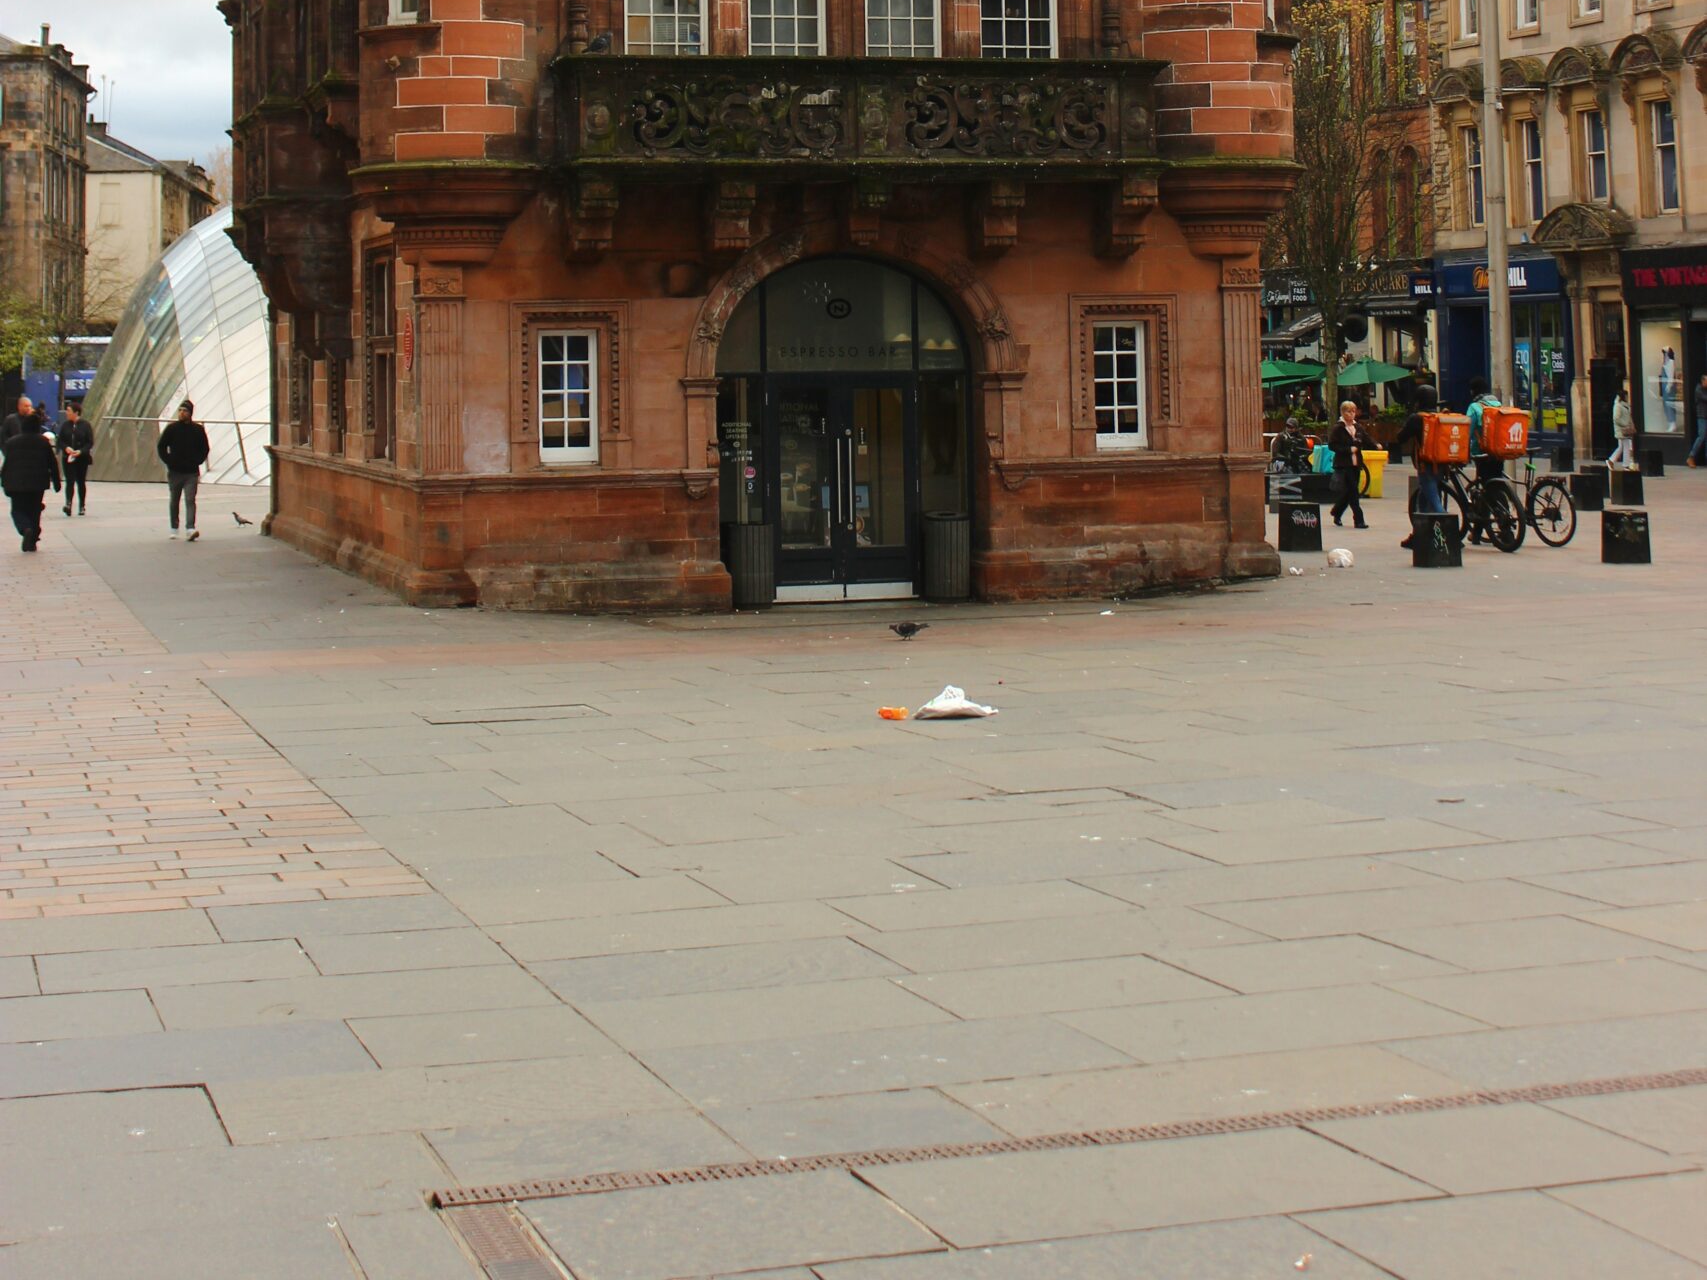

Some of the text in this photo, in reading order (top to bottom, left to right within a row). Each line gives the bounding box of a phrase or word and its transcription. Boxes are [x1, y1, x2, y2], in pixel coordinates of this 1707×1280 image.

[1632, 267, 1658, 288] THE
[1414, 285, 1432, 294] HILL
[1292, 294, 1308, 302] FOOD
[780, 345, 898, 359] ESPRESSO BAR
